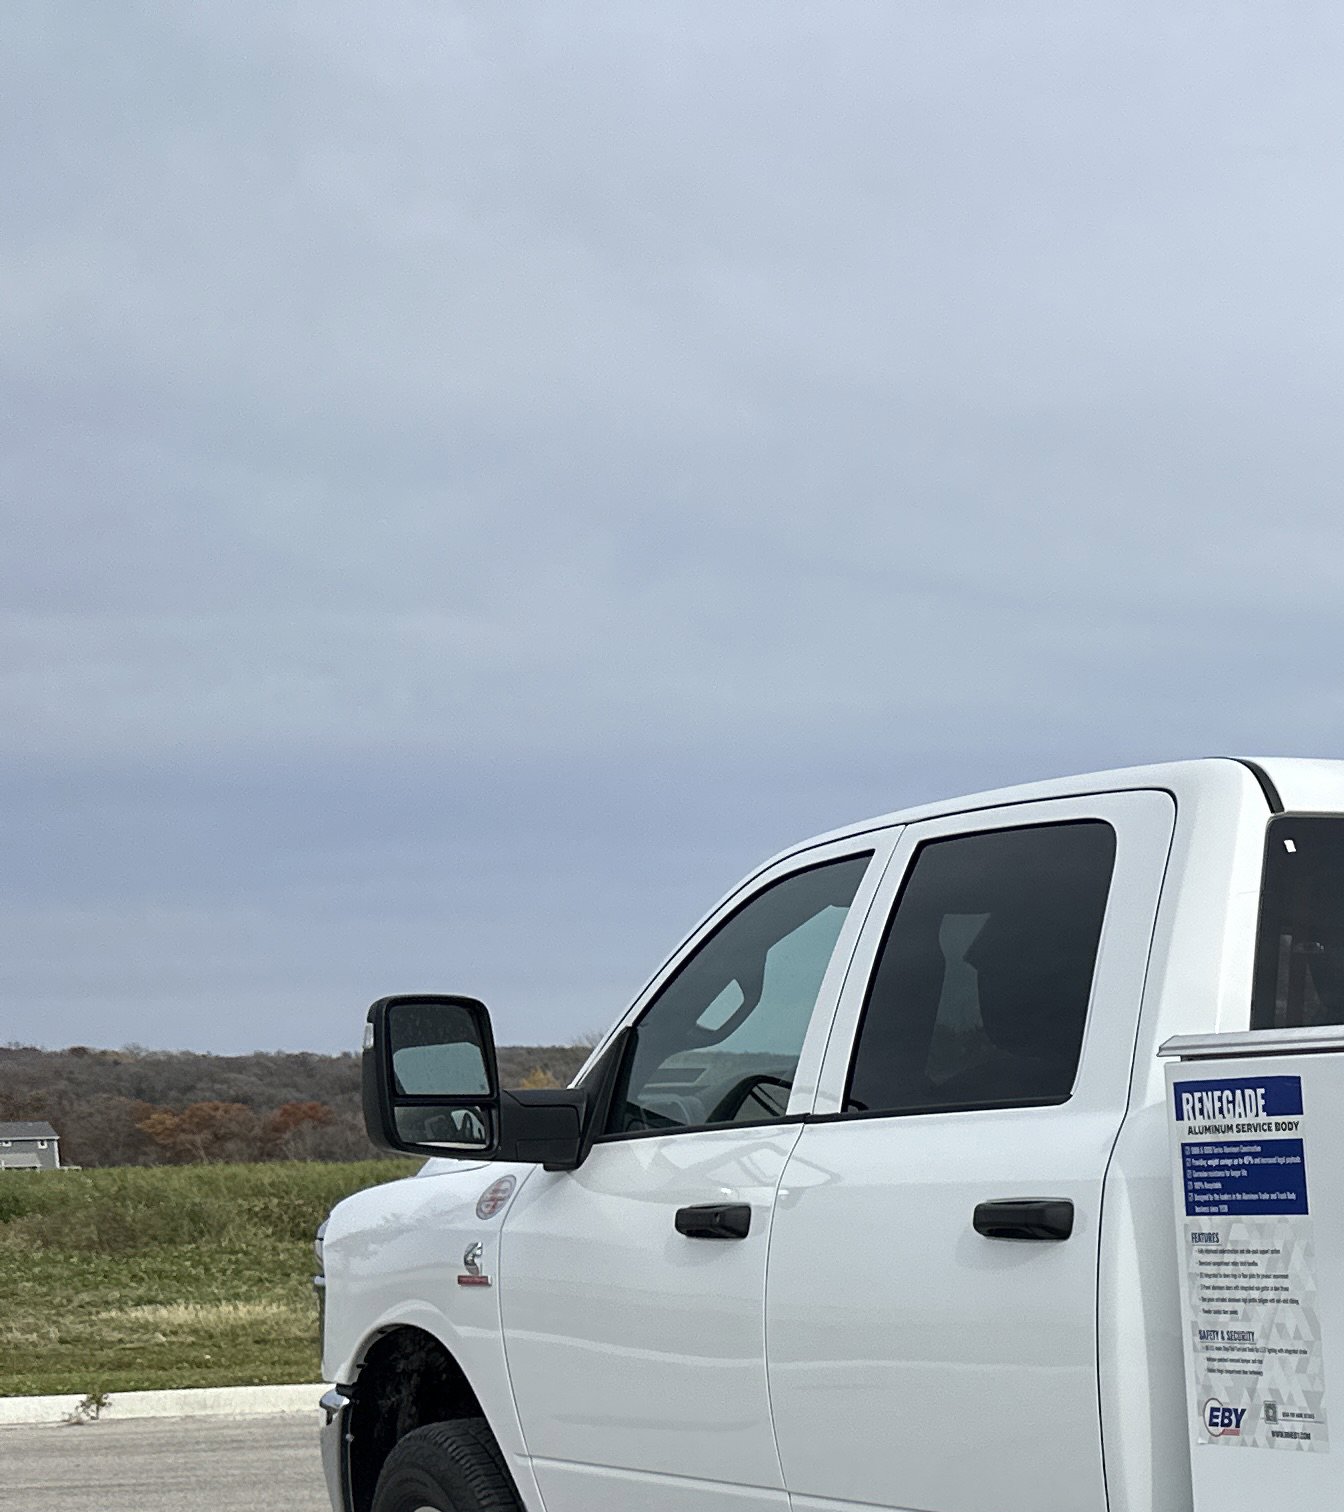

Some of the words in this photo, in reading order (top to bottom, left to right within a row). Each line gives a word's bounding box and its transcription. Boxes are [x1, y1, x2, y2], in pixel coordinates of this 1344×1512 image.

[1182, 1088, 1267, 1120] RENEGADE
[1187, 1123, 1234, 1135] ALUMINUM
[1236, 1122, 1273, 1133] SERVICE
[1275, 1121, 1300, 1131] BODY
[1191, 1232, 1219, 1243] FEATURES
[1199, 1329, 1218, 1341] SAFETY
[1227, 1330, 1255, 1342] SECURITY
[1208, 1407, 1246, 1428] EBY
